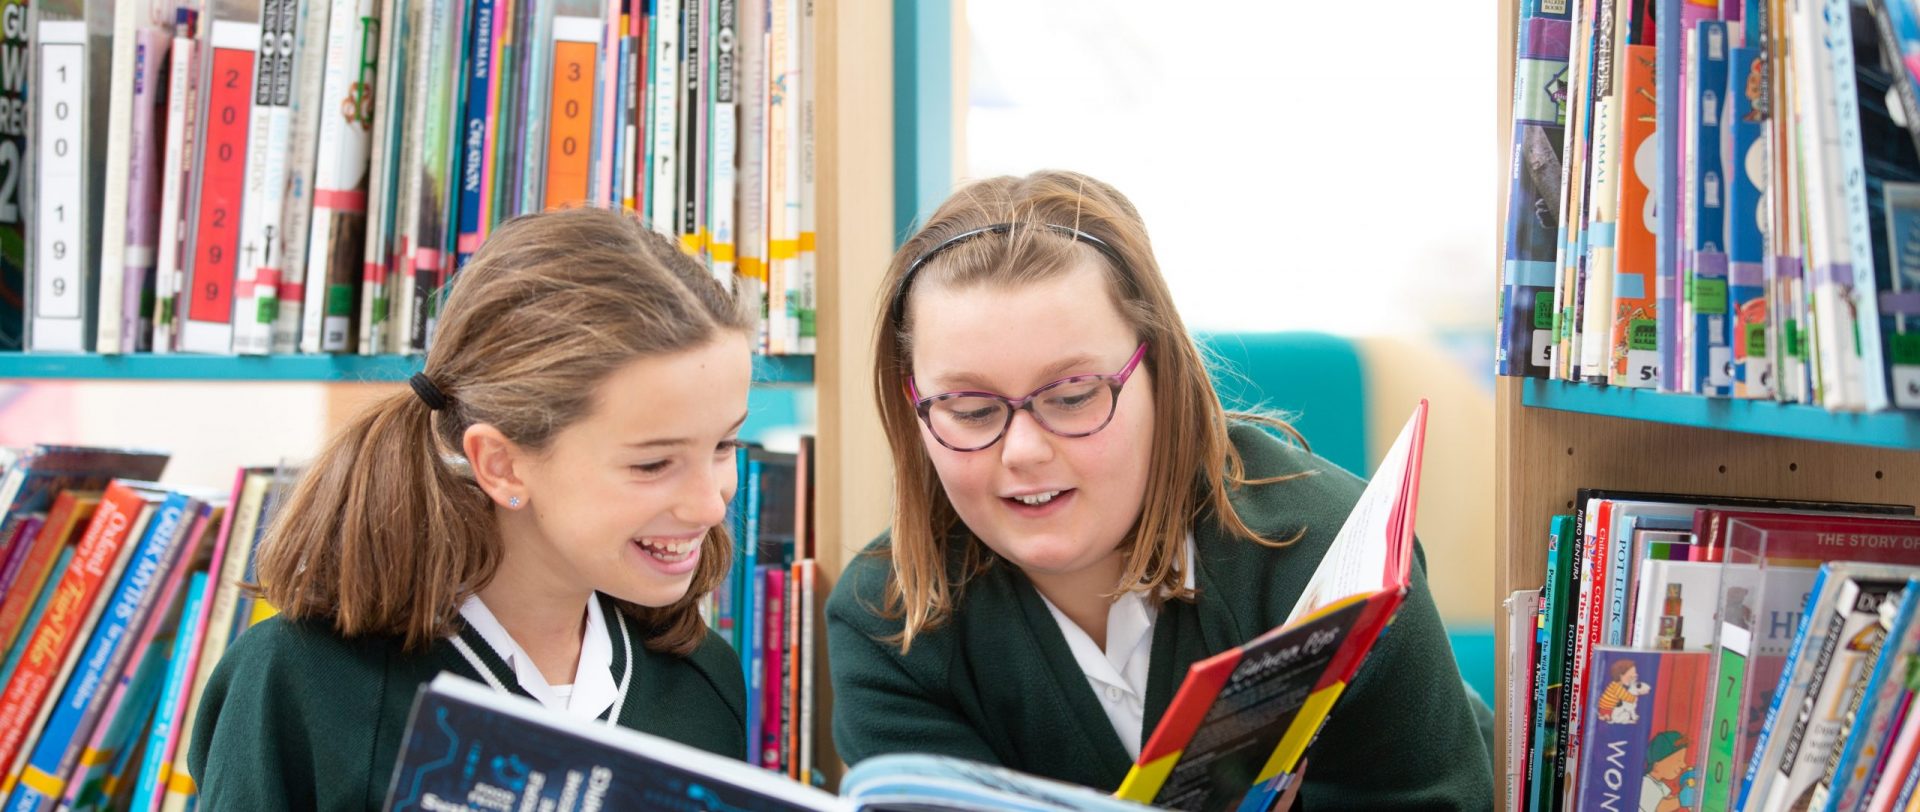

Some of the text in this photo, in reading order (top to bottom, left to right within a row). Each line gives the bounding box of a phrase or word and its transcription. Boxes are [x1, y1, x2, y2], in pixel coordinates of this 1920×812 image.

[475, 7, 490, 79] FOREMAN
[256, 56, 273, 106] GUIDES
[274, 56, 290, 106] GUIDES
[717, 54, 733, 102] GUIDES
[804, 100, 815, 141] HARRIET
[1597, 103, 1608, 186] MAMMAL
[251, 114, 269, 194] RELIGION
[464, 117, 484, 194] CREATION
[87, 510, 127, 577] Oxford
[1572, 508, 1584, 580] PIERO VENTURA
[1596, 527, 1606, 581] Children's
[1816, 533, 1920, 549] THE STORY OF
[115, 556, 157, 621] MYTHS
[1544, 569, 1555, 623] Perspectives
[1612, 540, 1627, 623] POT LUCK
[1231, 627, 1341, 682] Guinea Pigs
[1540, 653, 1549, 672] Wild
[1542, 639, 1550, 652] The
[1569, 591, 1587, 723] The Baking Book
[1539, 674, 1548, 690] Side
[1557, 623, 1576, 778] FOOD THROUGH THE AGES
[1527, 748, 1536, 781] Hamsters
[1781, 719, 1805, 776] GUIDES
